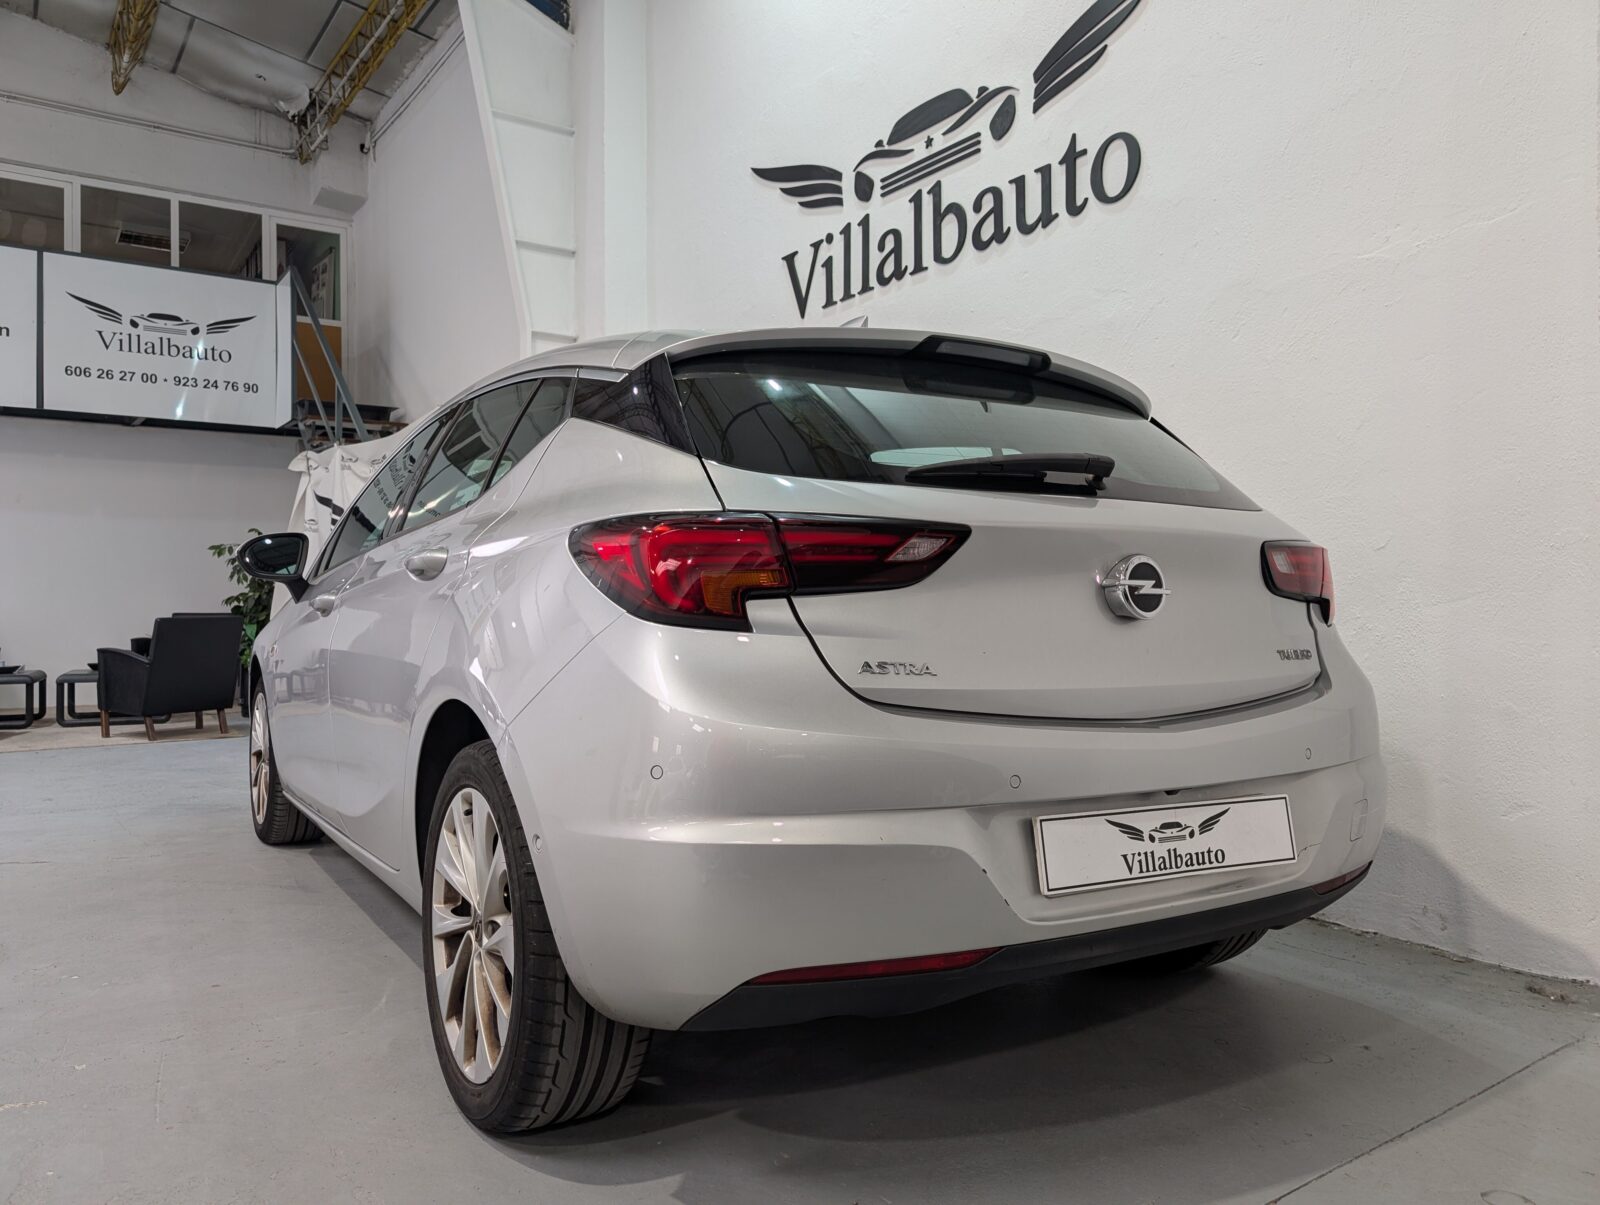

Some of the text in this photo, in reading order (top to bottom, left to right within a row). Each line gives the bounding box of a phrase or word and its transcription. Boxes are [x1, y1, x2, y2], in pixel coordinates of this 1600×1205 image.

[781, 131, 1142, 319] Villalbauto
[96, 329, 232, 364] Villalbauto
[64, 365, 259, 394] 606 26 27 00 923 24 76 90
[857, 660, 938, 677] ASTRA
[1120, 846, 1226, 876] Villalbauto
